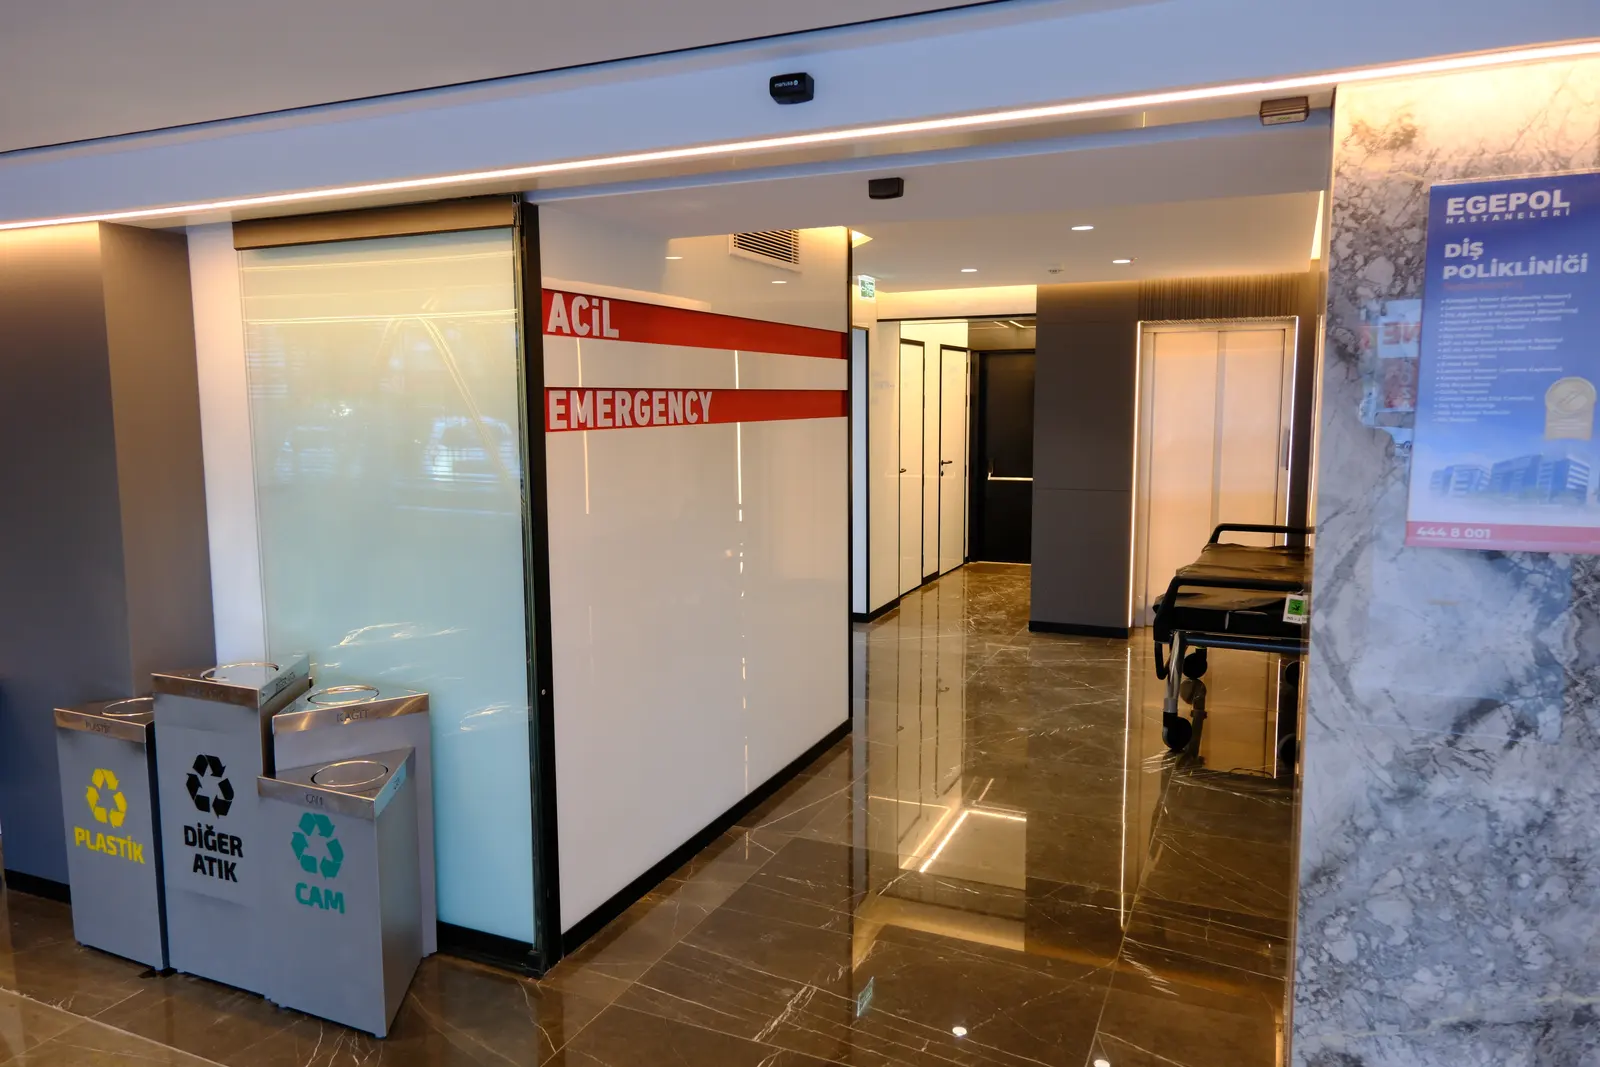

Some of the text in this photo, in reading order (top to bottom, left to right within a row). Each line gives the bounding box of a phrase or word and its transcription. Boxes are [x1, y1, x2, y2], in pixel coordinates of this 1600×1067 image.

[1446, 190, 1570, 216] EGEPOL
[1446, 208, 1570, 224] HASTANELERİ
[1444, 237, 1484, 261] DİŞ
[1442, 253, 1589, 280] POLİKLİNİĞİ
[548, 390, 713, 430] EMERGENCY
[1416, 526, 1491, 539] 444 8 001
[74, 826, 145, 865] PLASTİK
[183, 822, 244, 858] DİĞER
[193, 853, 239, 883] ATIK
[295, 882, 346, 914] CAM
